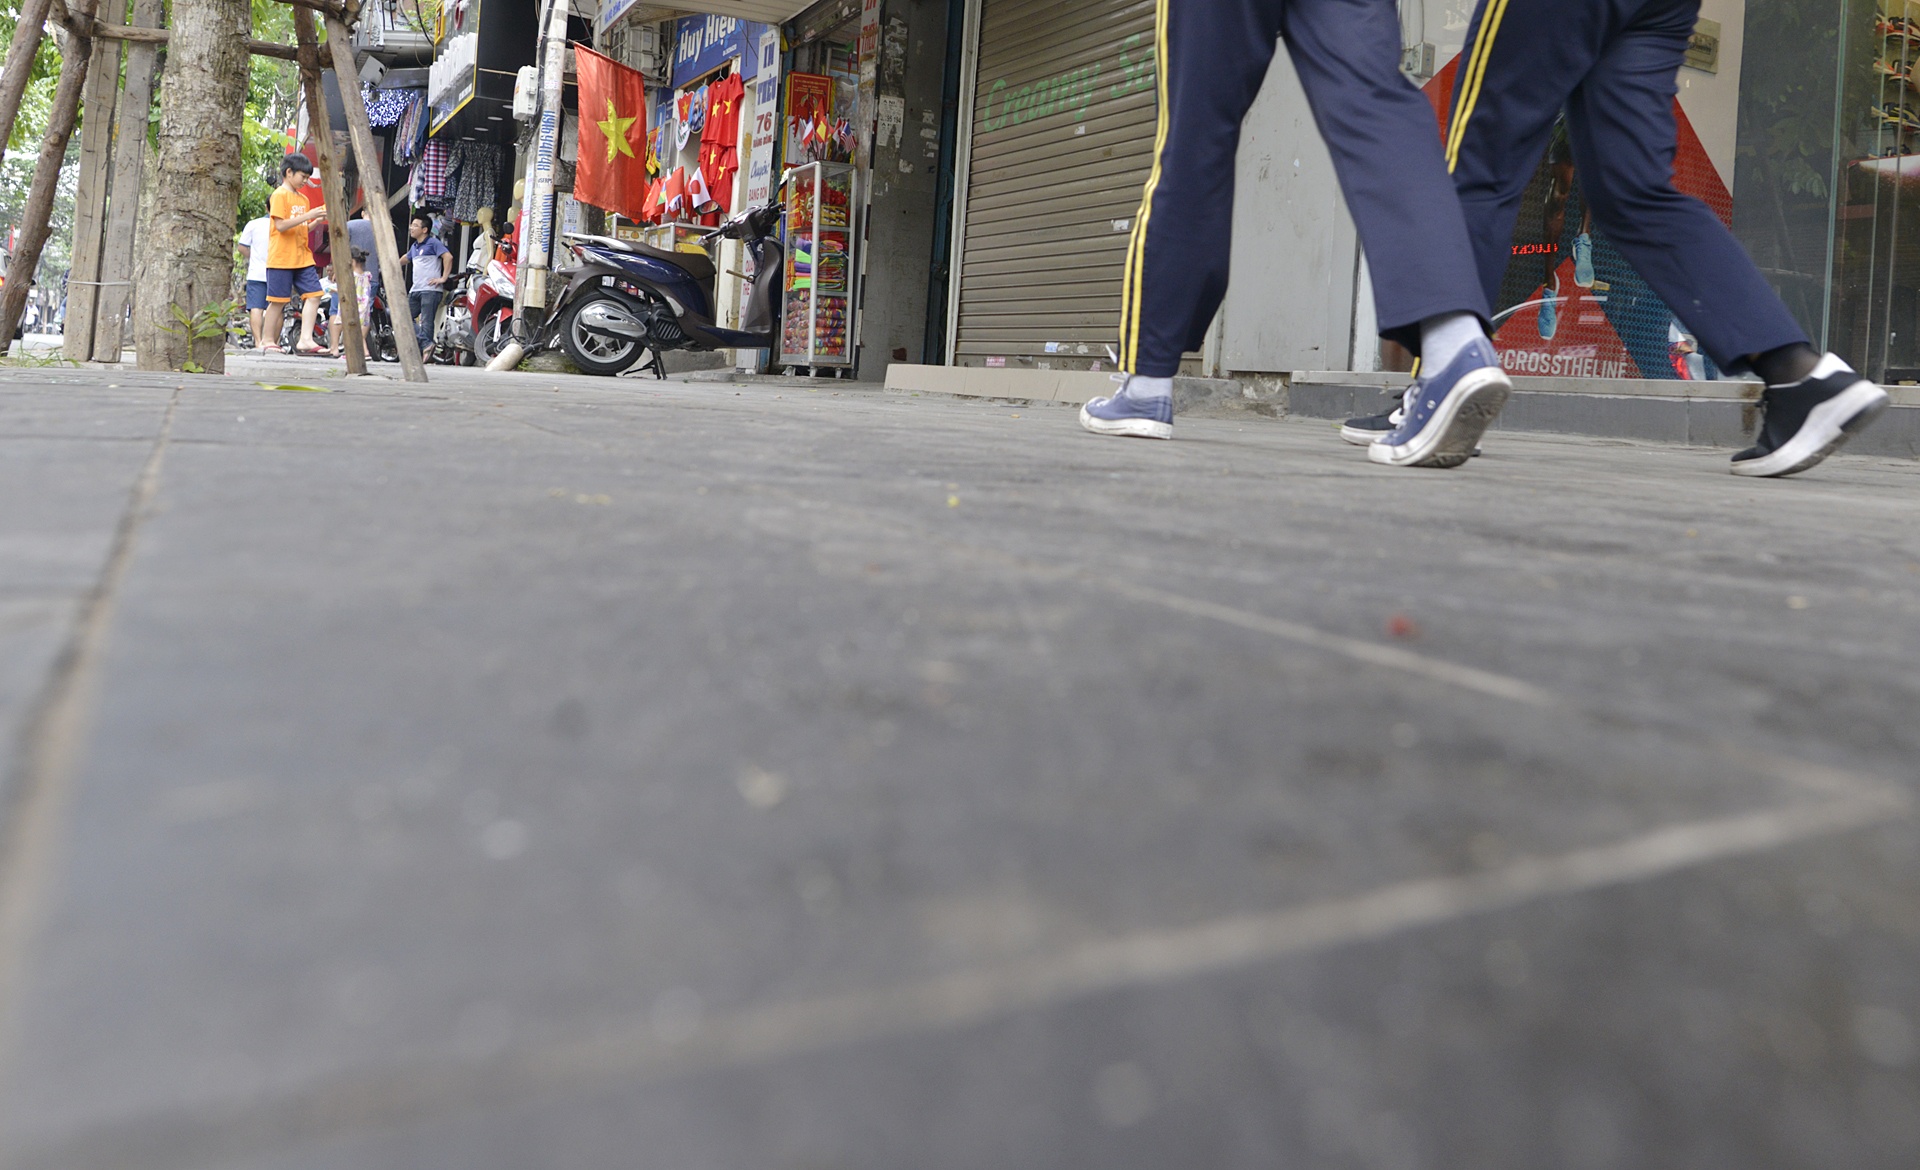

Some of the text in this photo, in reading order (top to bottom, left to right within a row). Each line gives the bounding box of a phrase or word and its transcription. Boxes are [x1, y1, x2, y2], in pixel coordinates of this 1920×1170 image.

[679, 27, 704, 64] Huy
[763, 41, 775, 69] IN
[983, 64, 1100, 132] Creamy
[756, 112, 772, 135] 76
